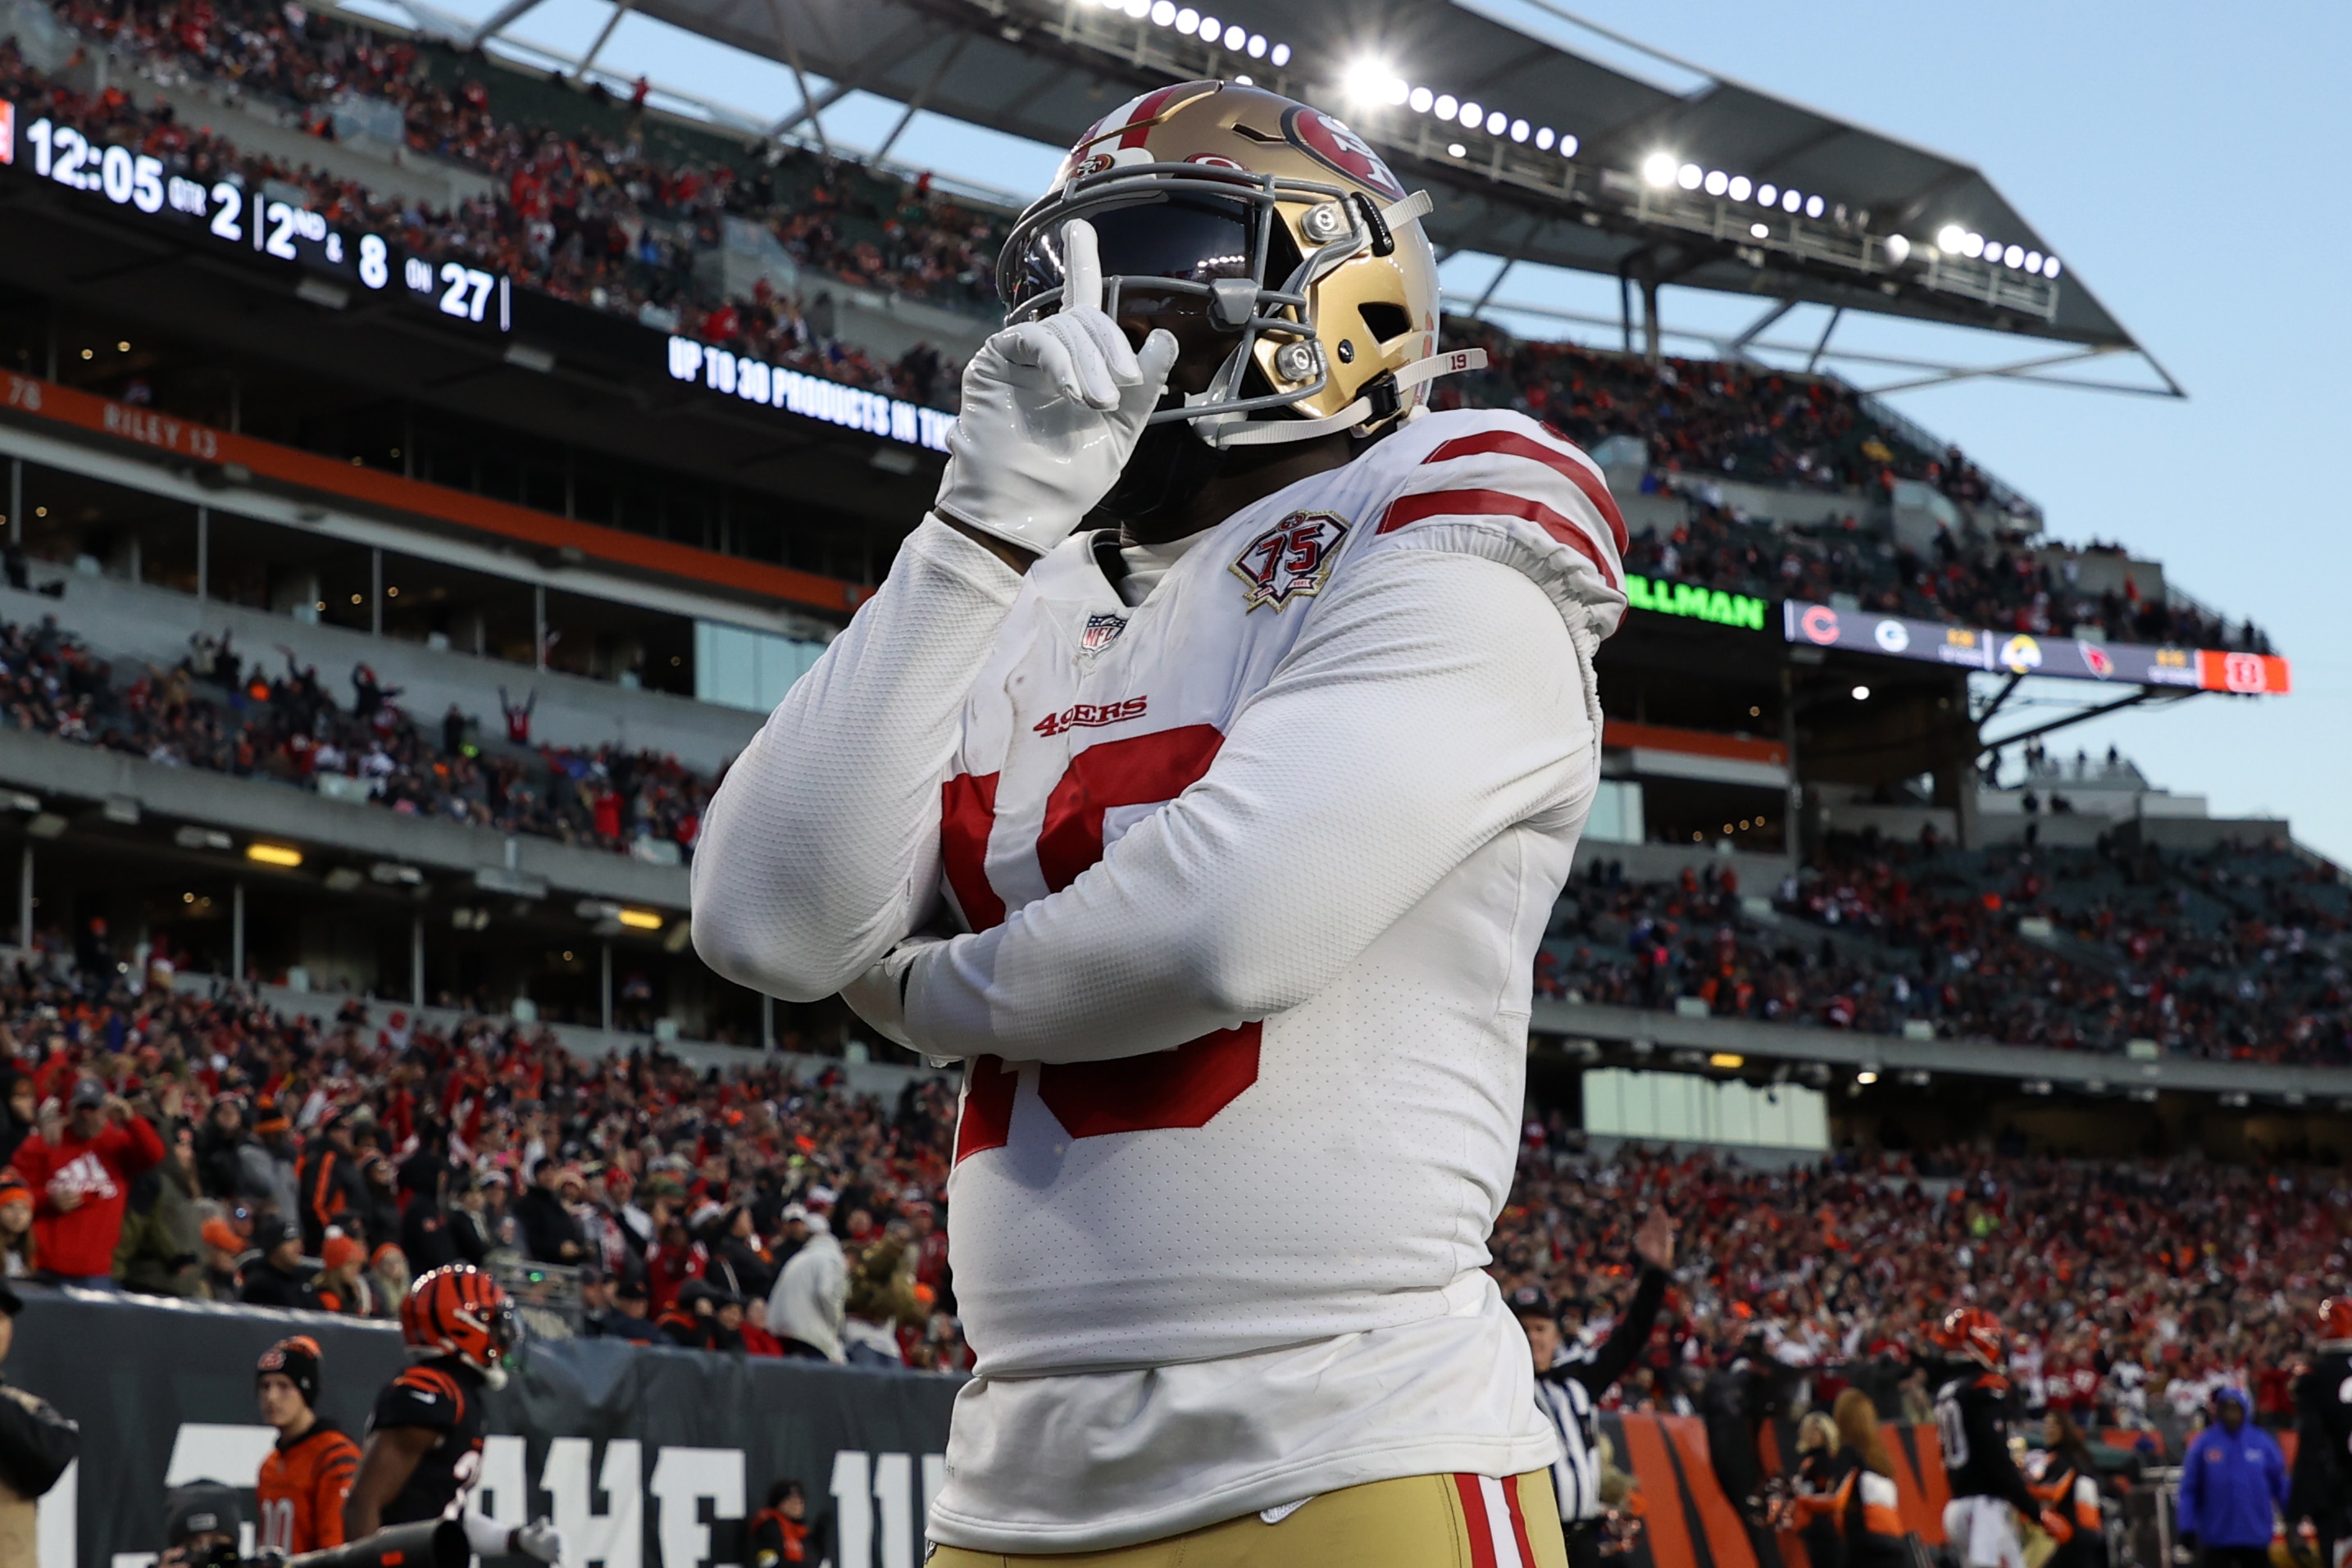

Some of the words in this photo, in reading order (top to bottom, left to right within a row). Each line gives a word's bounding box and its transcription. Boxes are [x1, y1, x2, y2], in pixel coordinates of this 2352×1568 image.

[26, 116, 164, 214] 12:05
[210, 181, 242, 242] 2
[358, 233, 389, 289] 8
[439, 261, 495, 323] 27
[1450, 353, 1467, 370] 19
[668, 334, 703, 382] UP
[704, 345, 738, 395] TO
[772, 367, 890, 436] PRODUCTS
[890, 399, 919, 444] IN
[917, 407, 959, 454] TH
[103, 402, 180, 448] RILEY
[1257, 521, 1325, 585] 75
[1626, 574, 1763, 630] ILLMAN
[1085, 627, 1116, 648] NFL
[1032, 695, 1148, 738] 49ERS
